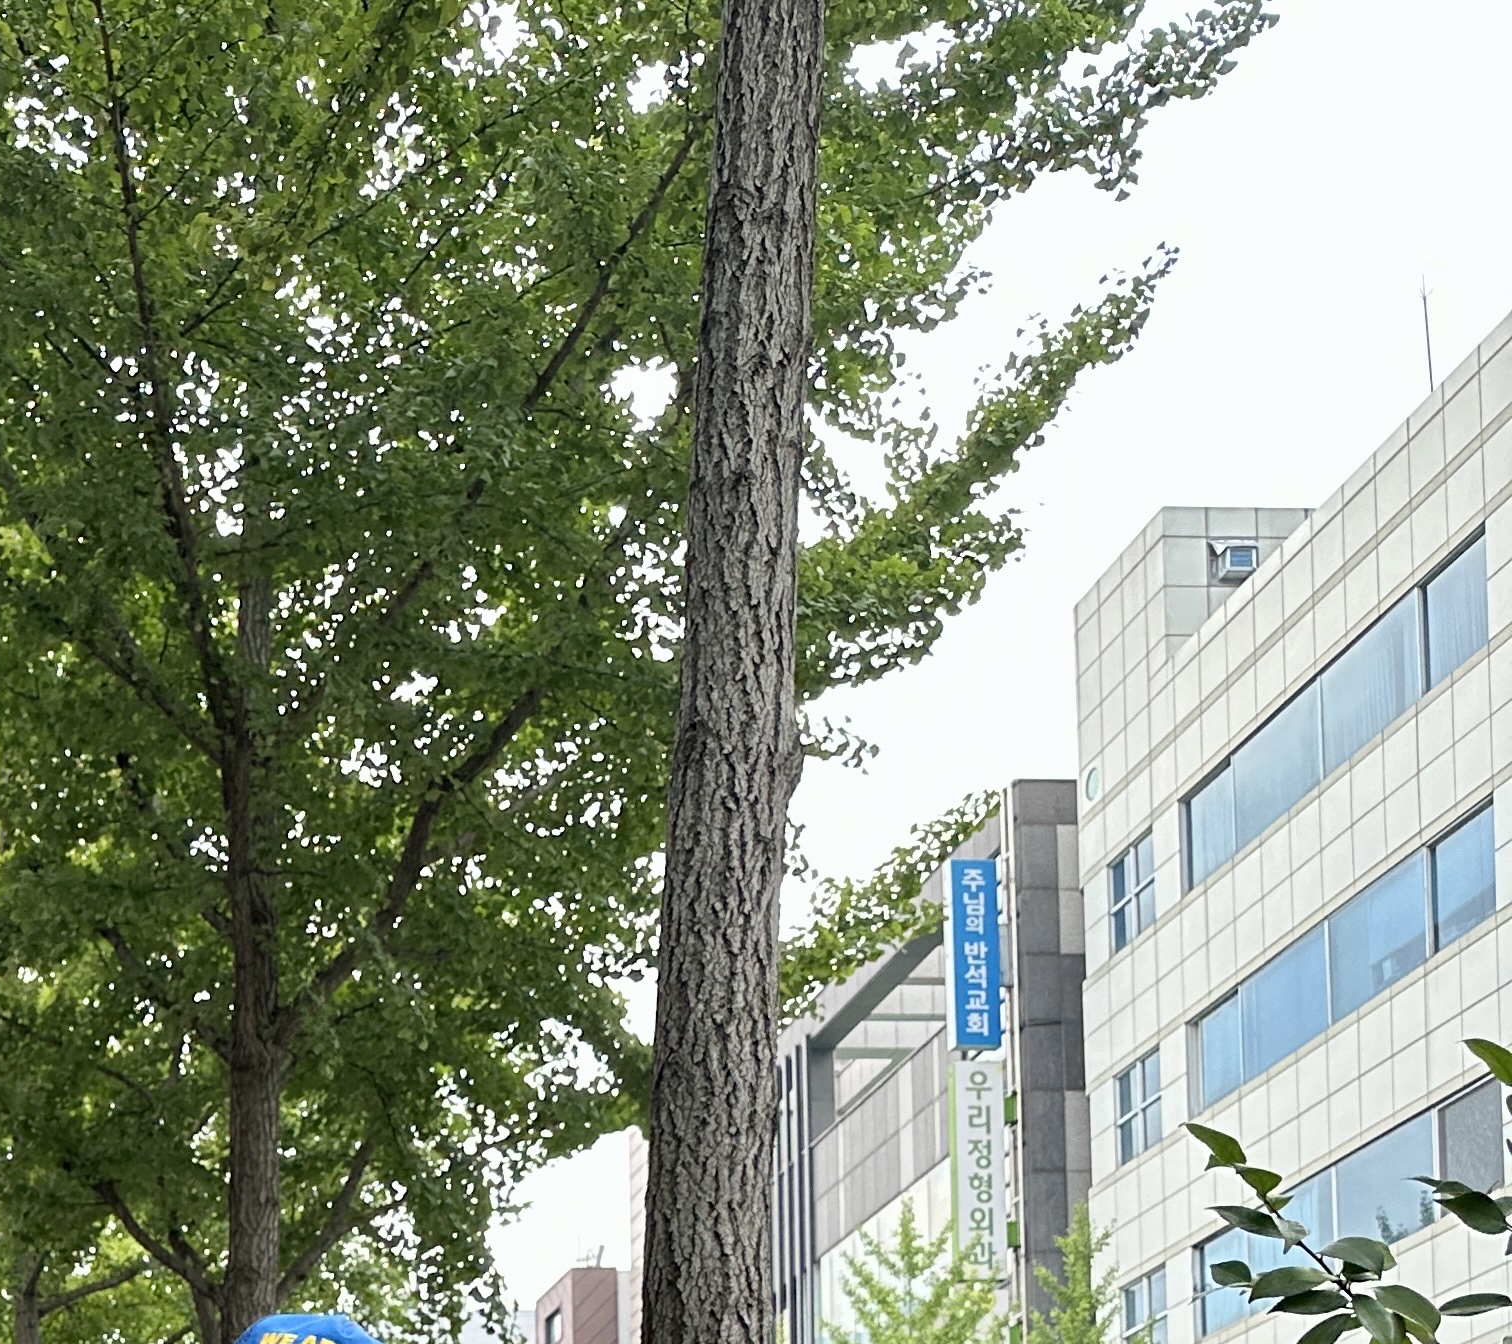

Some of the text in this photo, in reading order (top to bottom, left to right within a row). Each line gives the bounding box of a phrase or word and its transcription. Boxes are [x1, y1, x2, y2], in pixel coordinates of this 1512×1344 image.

[961, 868, 990, 1037] 주님의 반석교회
[965, 1069, 997, 1271] 우리정형외과
